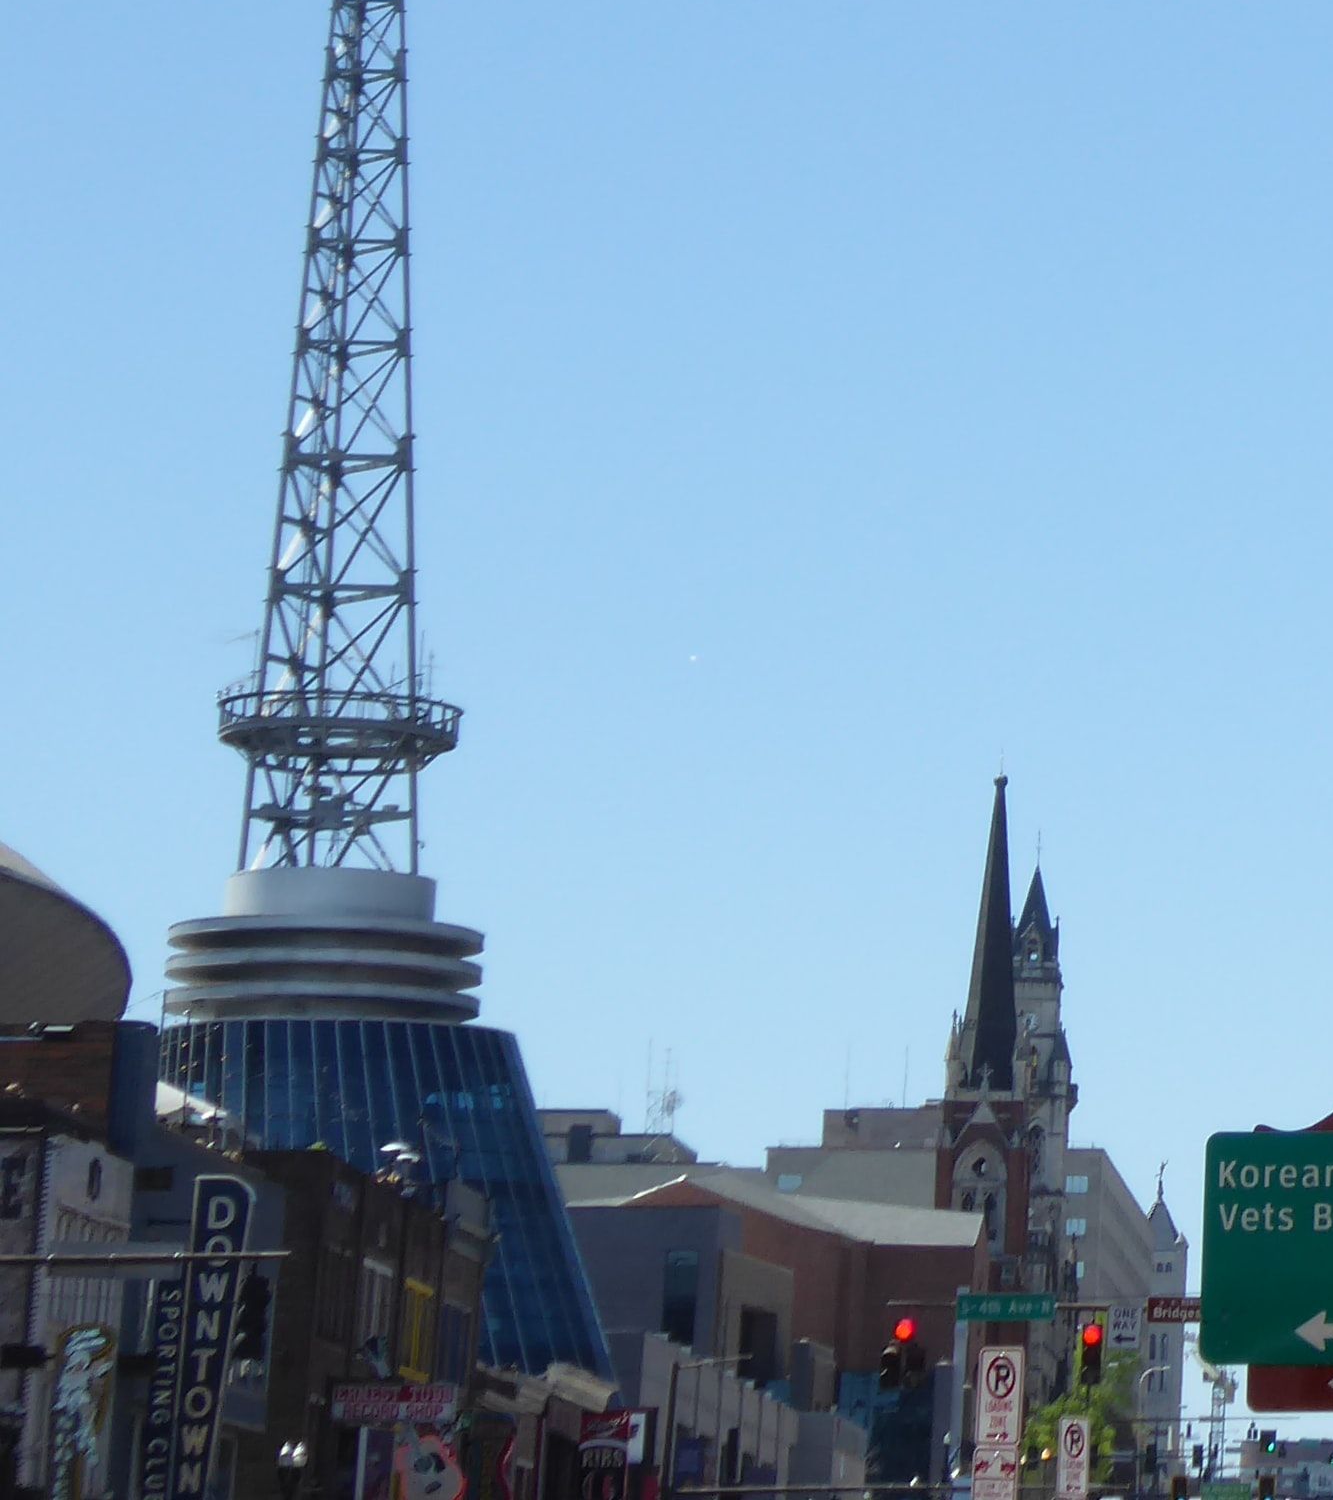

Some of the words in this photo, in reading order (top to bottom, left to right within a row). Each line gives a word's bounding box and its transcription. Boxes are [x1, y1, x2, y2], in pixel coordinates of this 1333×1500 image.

[1217, 1202, 1295, 1232] Vets
[1112, 1320, 1137, 1332] WAY
[1113, 1307, 1138, 1320] ONE
[152, 1288, 182, 1427] SPORTING
[177, 1195, 237, 1494] DOWNTOWN
